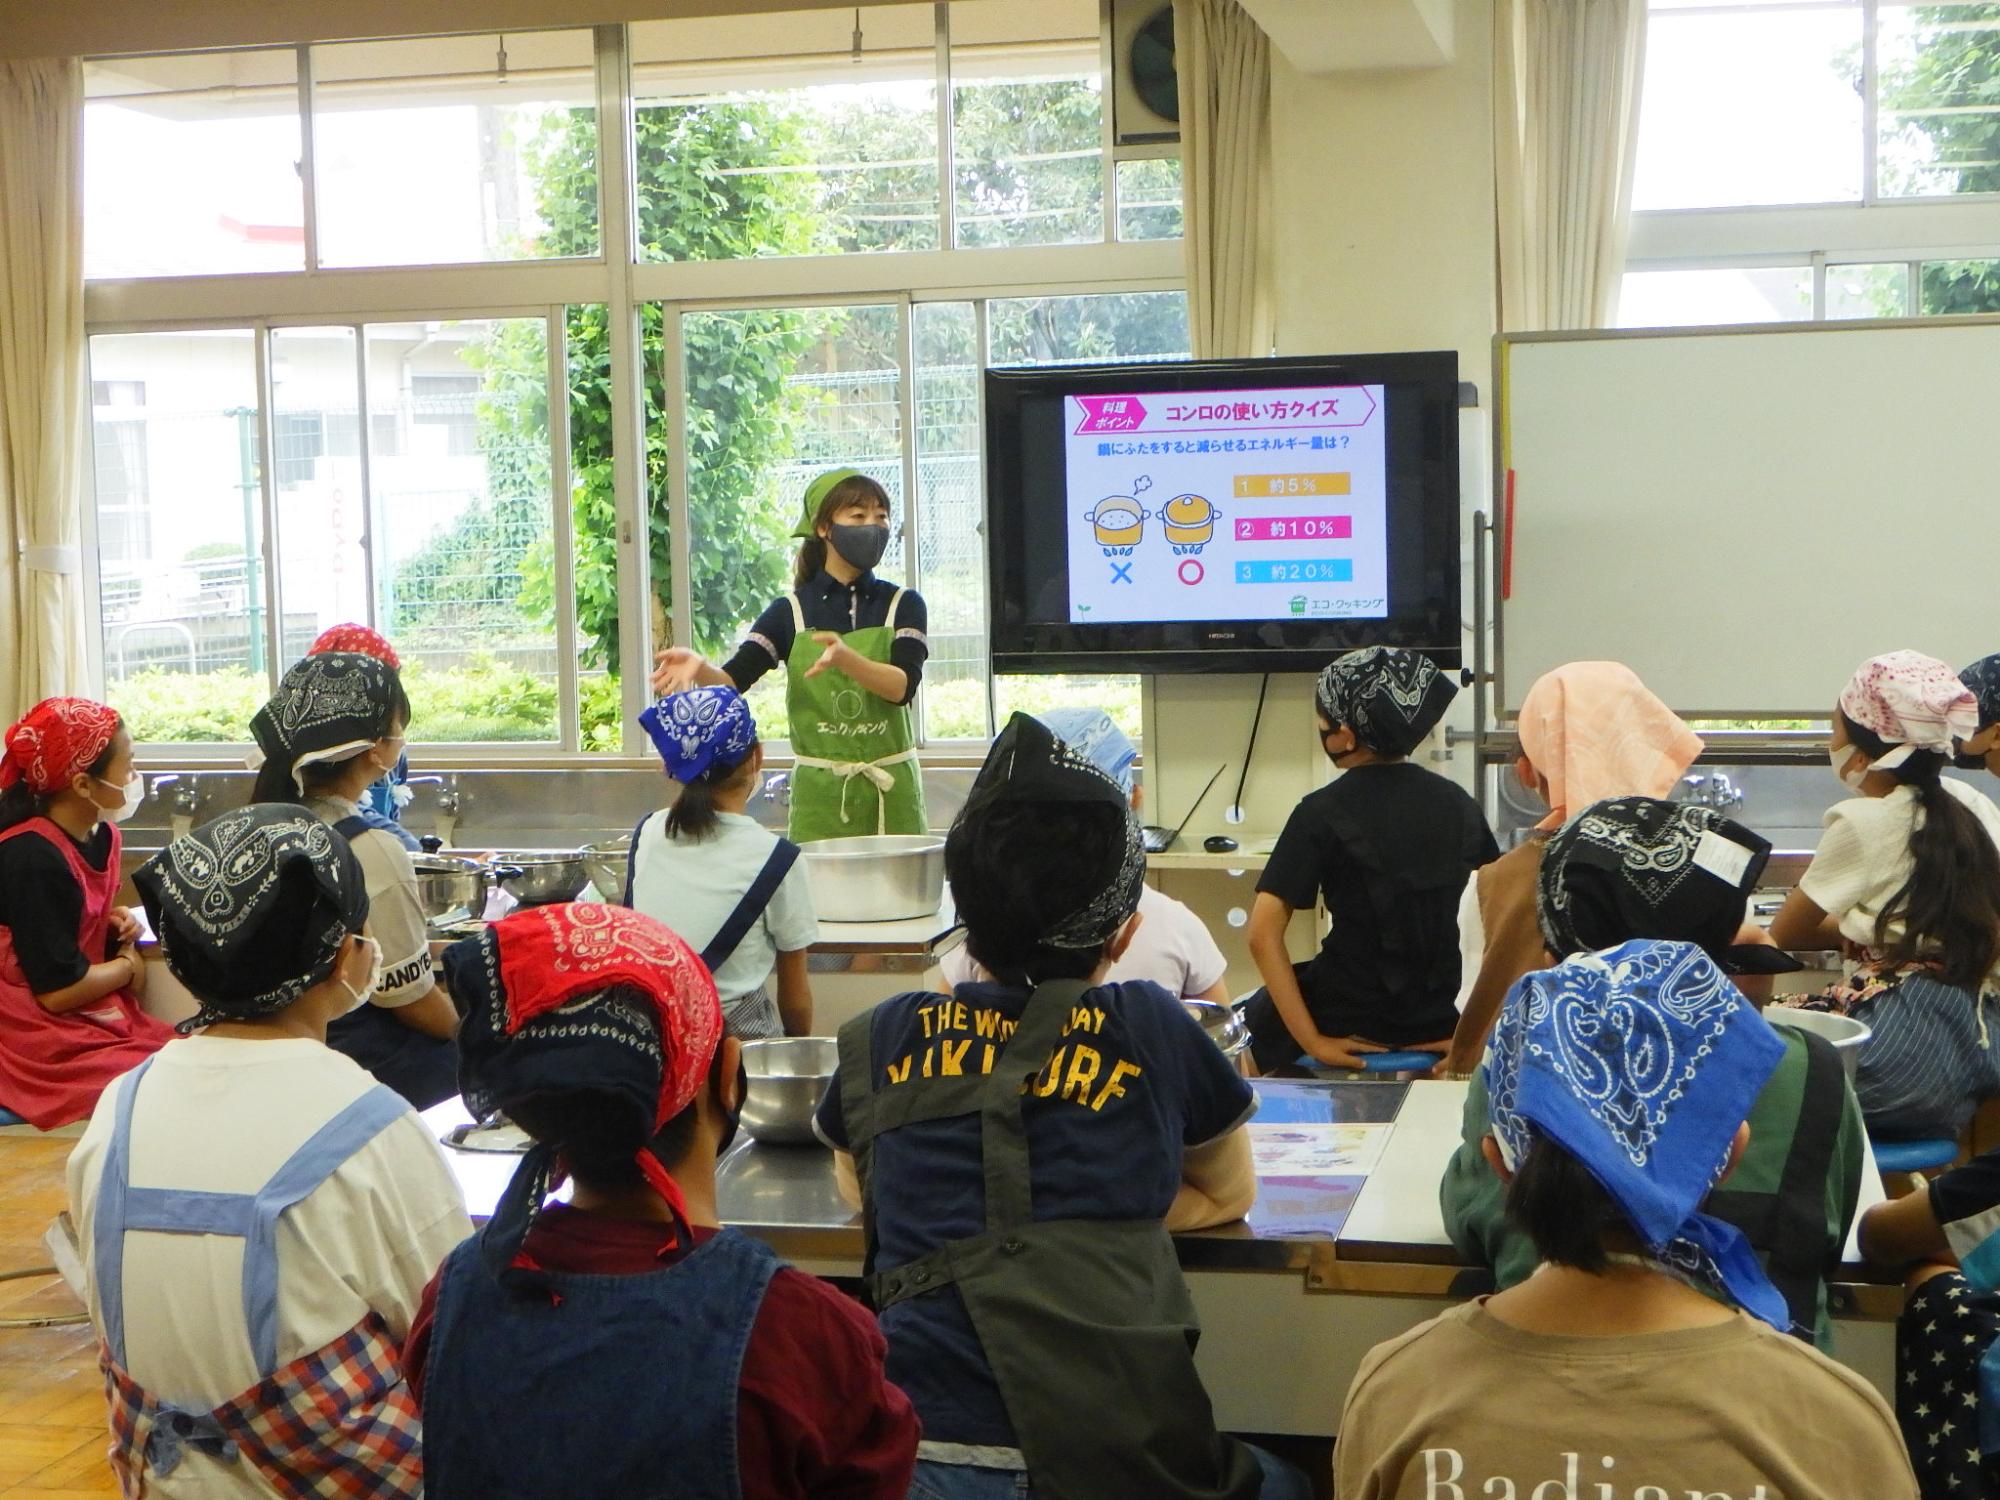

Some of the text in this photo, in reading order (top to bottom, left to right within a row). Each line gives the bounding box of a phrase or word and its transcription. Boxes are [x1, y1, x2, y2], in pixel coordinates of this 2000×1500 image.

[1102, 401, 1128, 414] 料理
[1166, 399, 1339, 421] コンロの使い方クイズ
[1096, 417, 1135, 429] ポイント
[1240, 480, 1248, 492] 1
[1242, 566, 1251, 579] 3
[917, 1001, 968, 1038] THE
